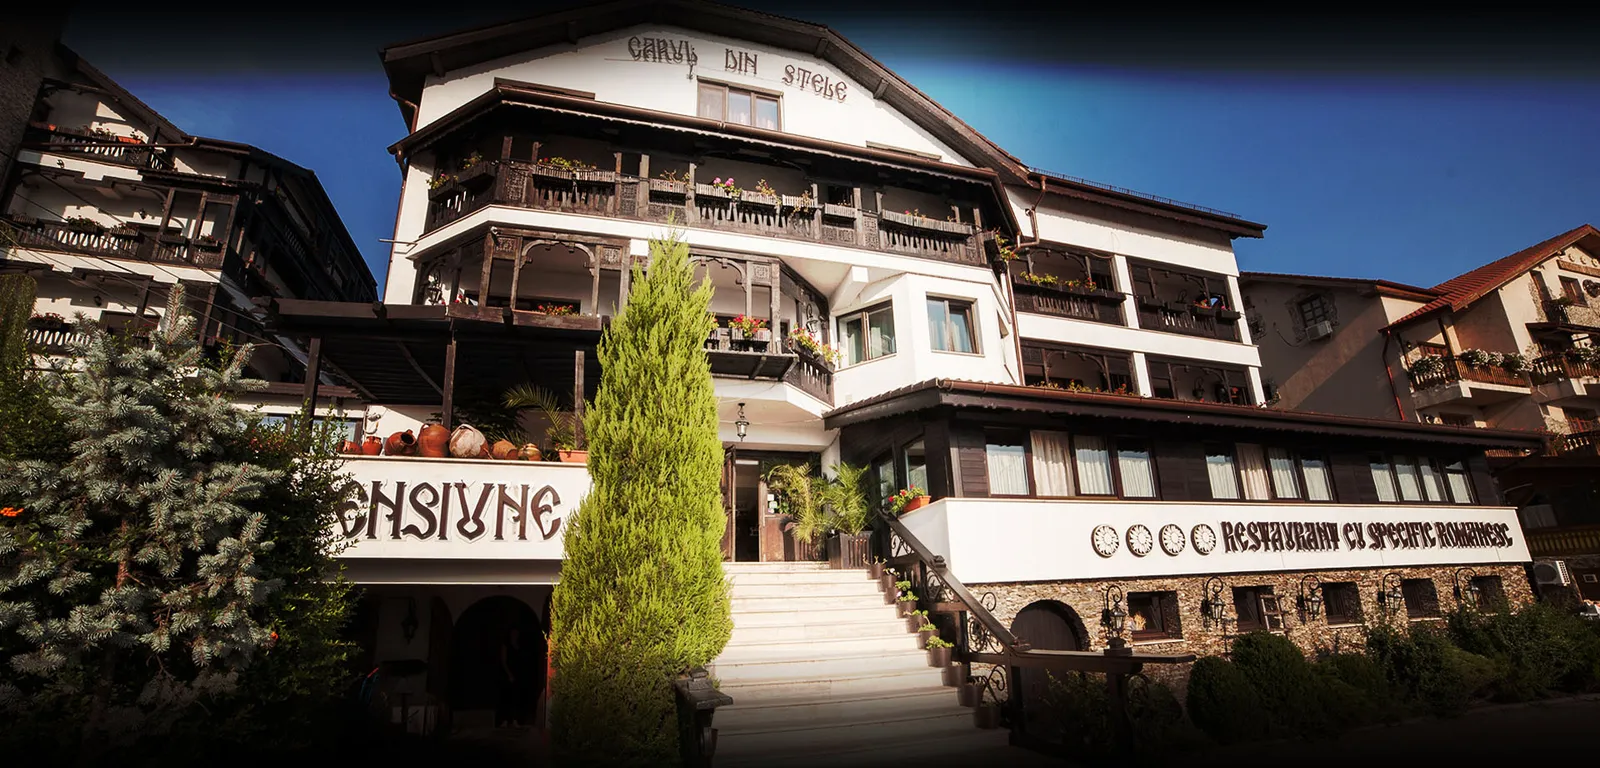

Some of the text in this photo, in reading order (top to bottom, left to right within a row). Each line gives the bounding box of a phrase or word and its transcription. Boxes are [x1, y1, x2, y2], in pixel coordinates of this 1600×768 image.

[725, 48, 758, 75] DIN
[782, 64, 848, 101] STELE
[327, 479, 562, 541] ENSIUNE
[1367, 522, 1436, 550] SPECIFIC
